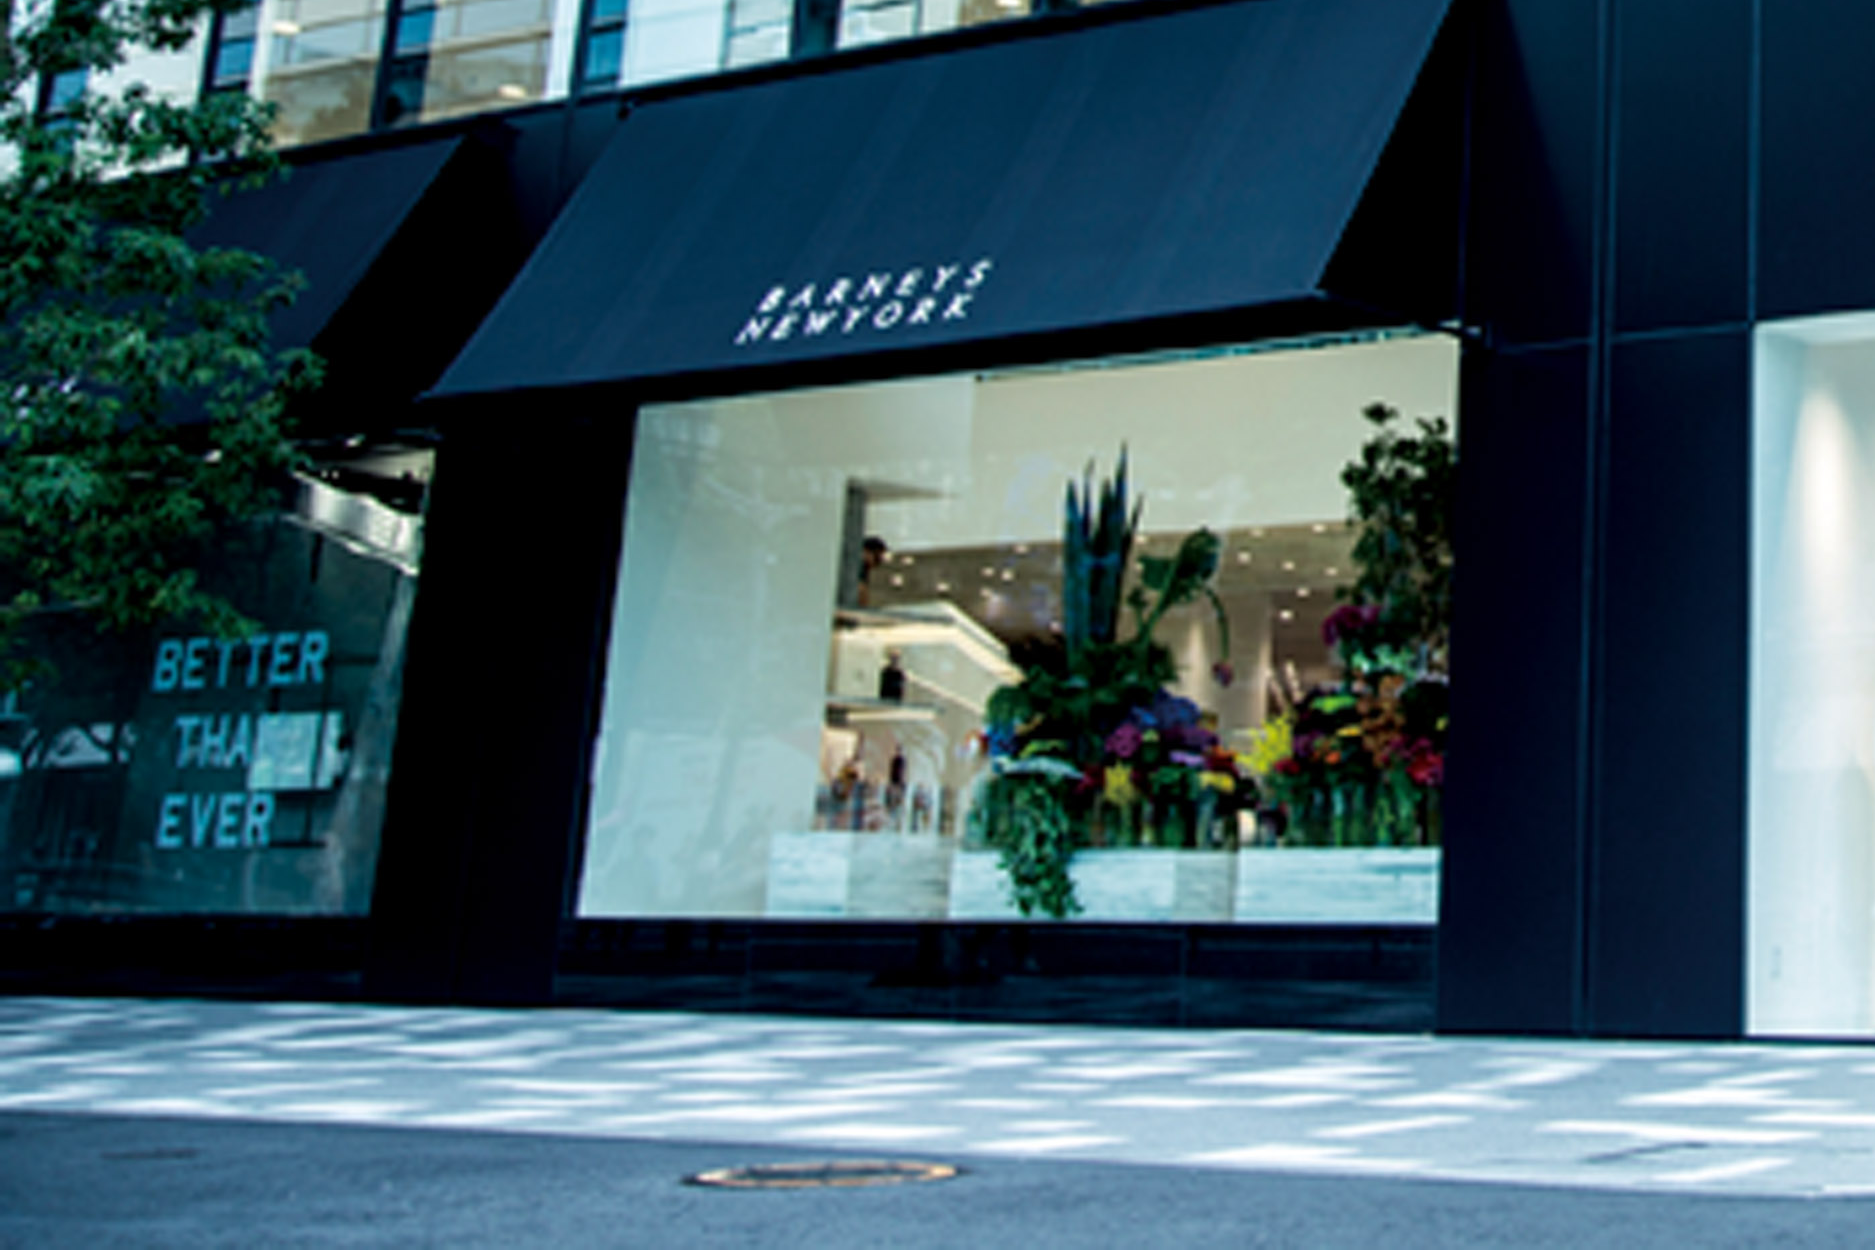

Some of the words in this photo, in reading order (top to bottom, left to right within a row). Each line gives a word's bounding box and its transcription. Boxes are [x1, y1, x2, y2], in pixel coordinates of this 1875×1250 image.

[758, 258, 992, 312] BARNEYS
[152, 632, 329, 691] BETTER
[156, 793, 275, 848] EVER
